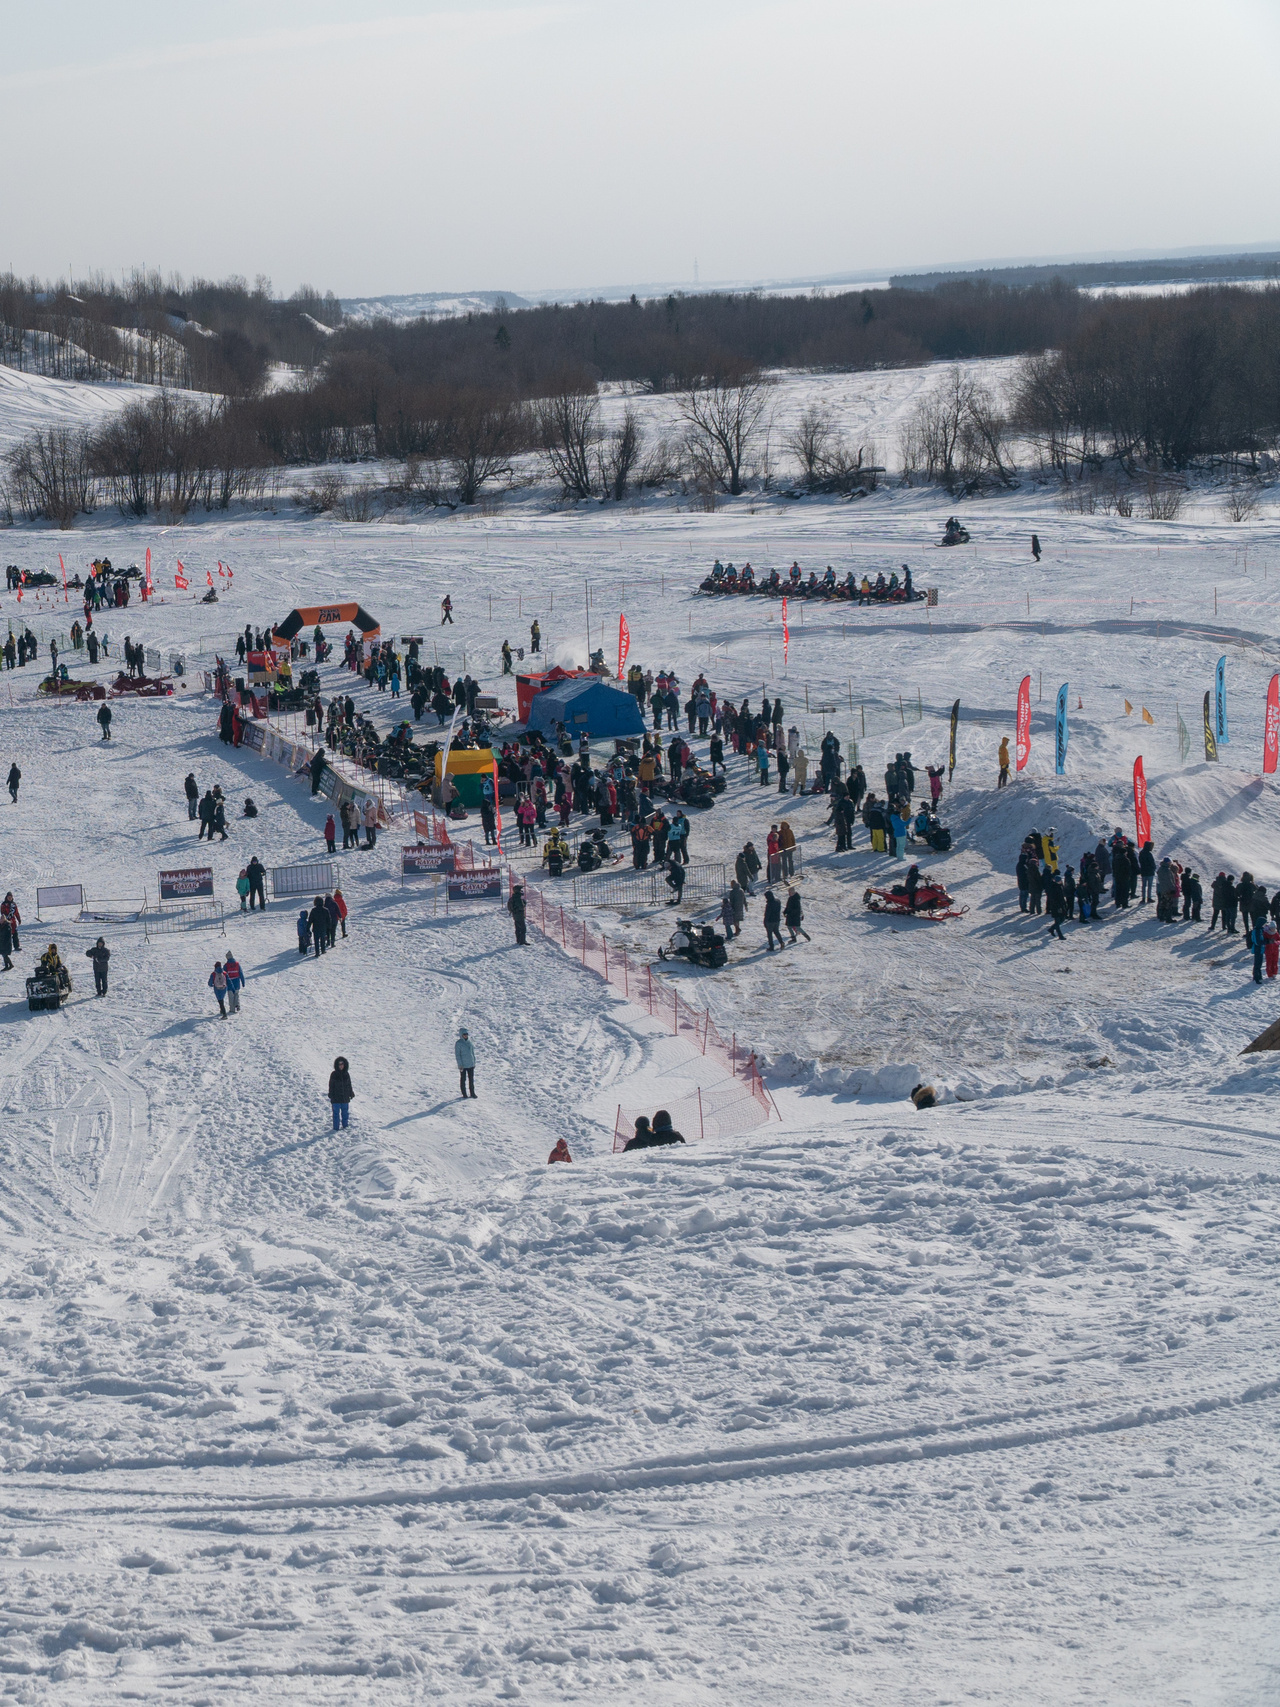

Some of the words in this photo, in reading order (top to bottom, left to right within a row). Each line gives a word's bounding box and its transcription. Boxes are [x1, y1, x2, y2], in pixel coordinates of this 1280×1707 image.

[417, 858, 440, 866] KAYAK
[174, 882, 199, 890] KAYAK
[462, 883, 486, 891] KAYAK
